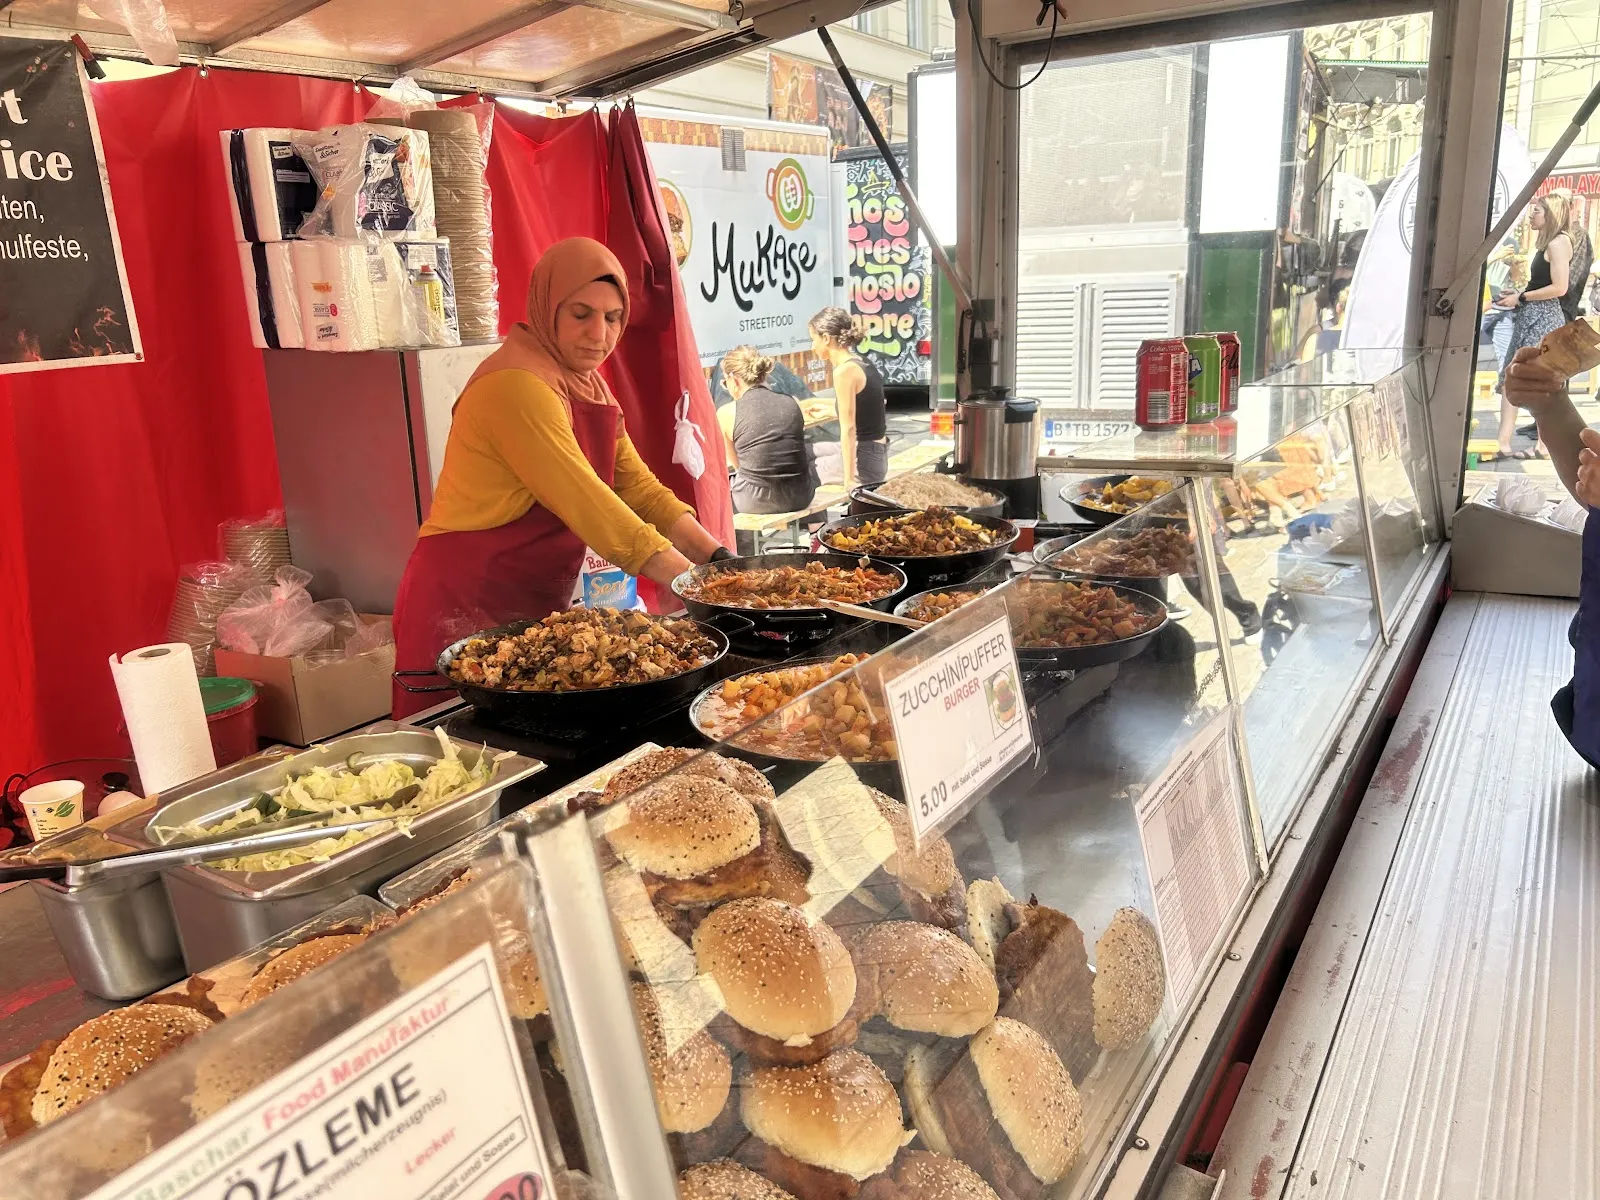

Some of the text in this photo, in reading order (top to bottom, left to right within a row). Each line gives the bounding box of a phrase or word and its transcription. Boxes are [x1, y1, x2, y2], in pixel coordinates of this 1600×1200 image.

[368, 202, 399, 213] CLASSIC
[739, 315, 794, 332] STREETFOOD
[1072, 423, 1091, 437] TB
[943, 677, 981, 712] BURGER
[920, 780, 948, 817] 5.00
[263, 1078, 327, 1130] Food
[331, 996, 450, 1085] Manufaktur
[404, 1127, 456, 1175] Lecker
